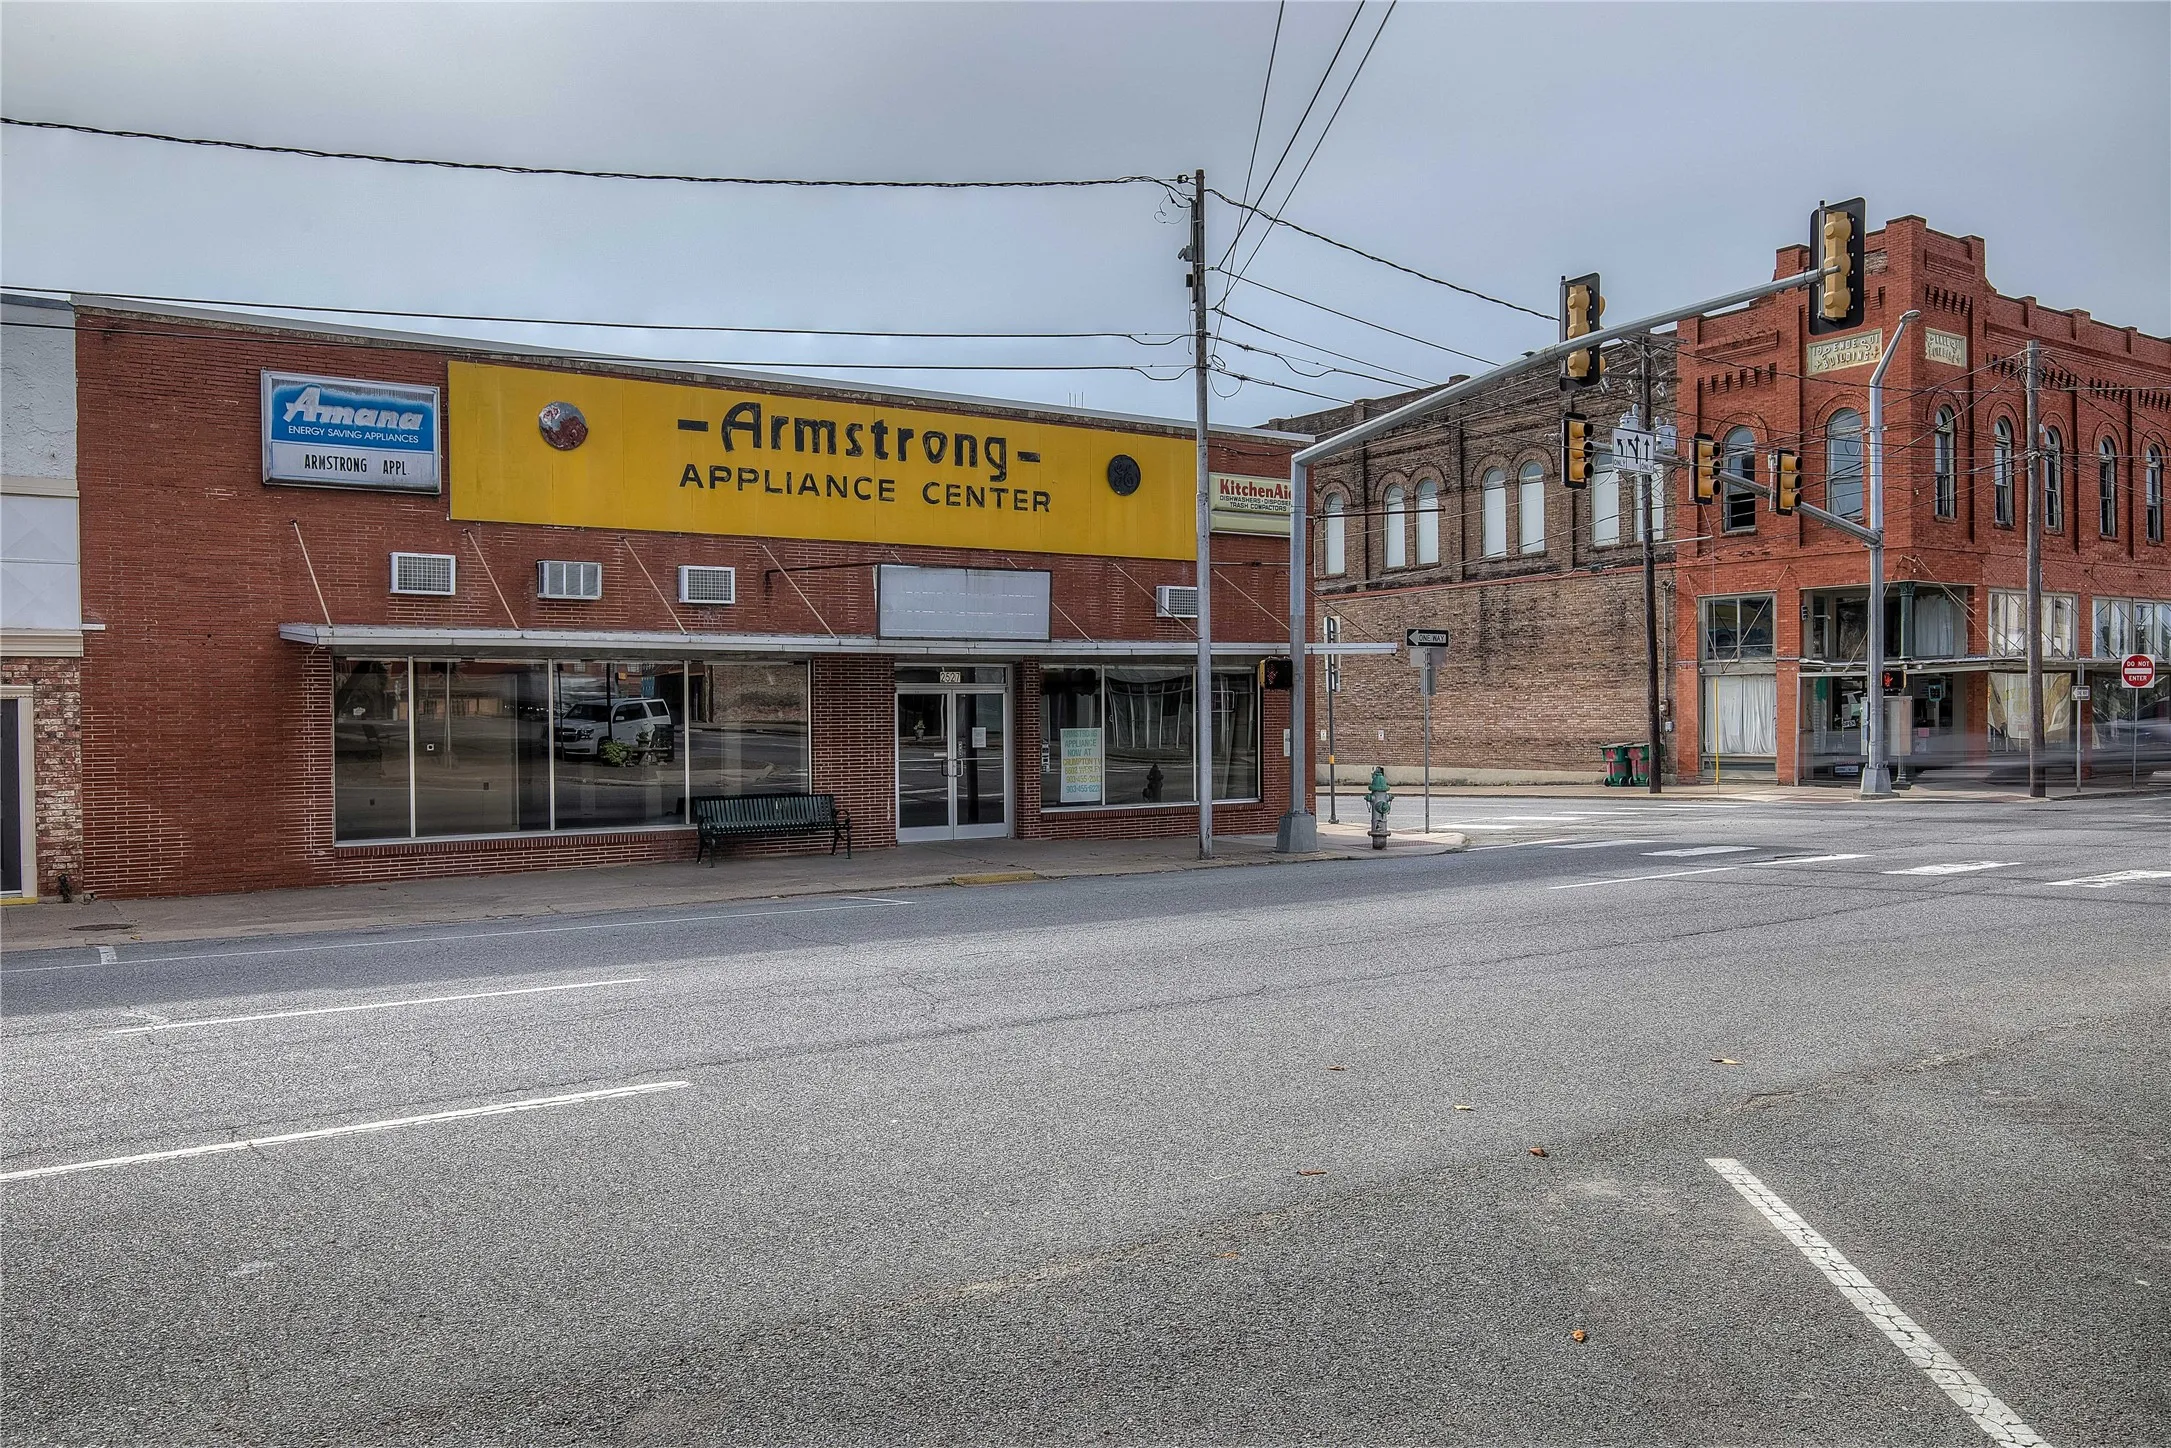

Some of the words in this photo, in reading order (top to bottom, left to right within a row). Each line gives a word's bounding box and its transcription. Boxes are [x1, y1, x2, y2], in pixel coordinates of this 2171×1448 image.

[1823, 351, 1870, 369] BUILDING
[283, 386, 424, 431] Amana
[288, 425, 325, 436] ENERGY
[327, 427, 362, 439] SAVING
[364, 431, 419, 443] APPLIANCES
[304, 454, 367, 473] ARMSTRONG
[679, 463, 895, 502] APPLIANCE
[922, 481, 1051, 513] CENTER
[1220, 479, 1291, 499] KitchenAi
[1064, 739, 1096, 748] APPLIANCE
[1068, 749, 1081, 757] NOW
[1084, 748, 1092, 756] AT
